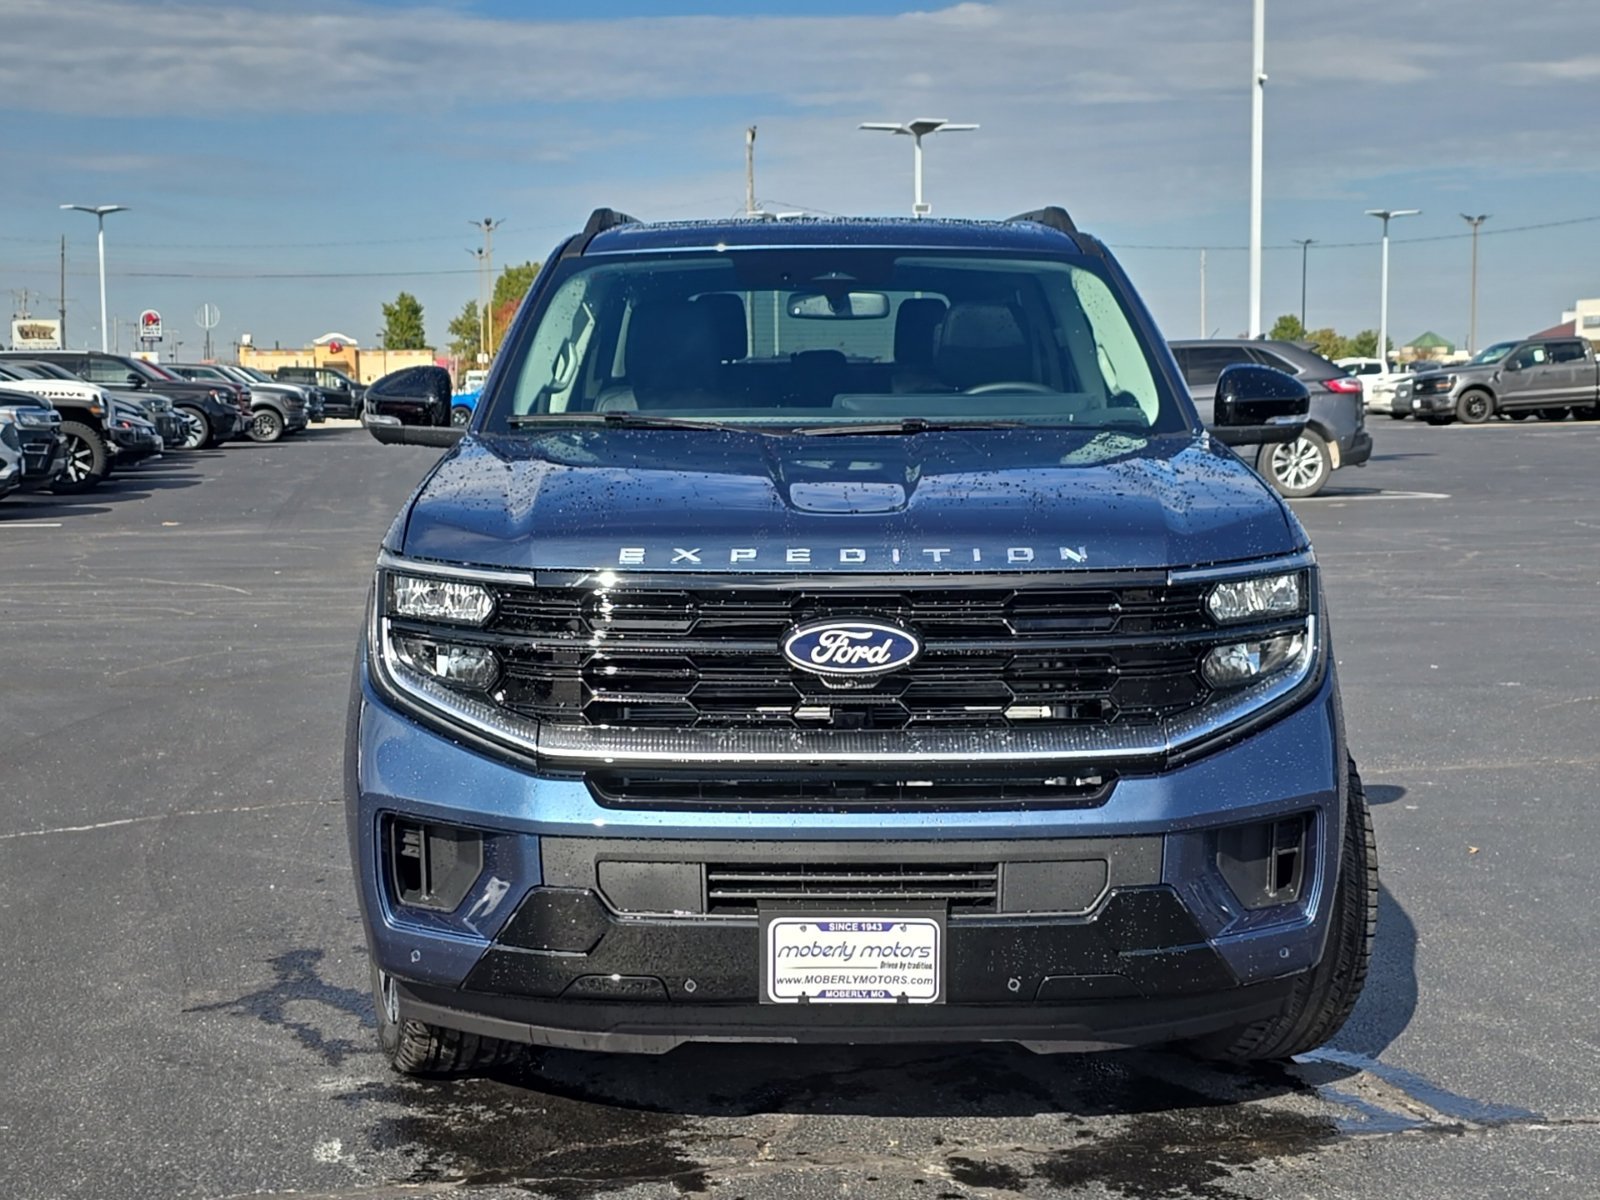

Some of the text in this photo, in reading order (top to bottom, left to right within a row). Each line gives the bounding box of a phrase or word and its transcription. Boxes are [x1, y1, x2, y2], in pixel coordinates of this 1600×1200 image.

[618, 546, 1088, 565] EXPEDITION
[811, 630, 893, 664] Ford
[828, 922, 883, 931] SINCE 1943
[777, 941, 932, 961] moberly motors
[899, 961, 906, 971] by
[776, 974, 933, 985] www.MOBERLYMOTORS.com
[825, 990, 885, 999] MOBERLY, MO
